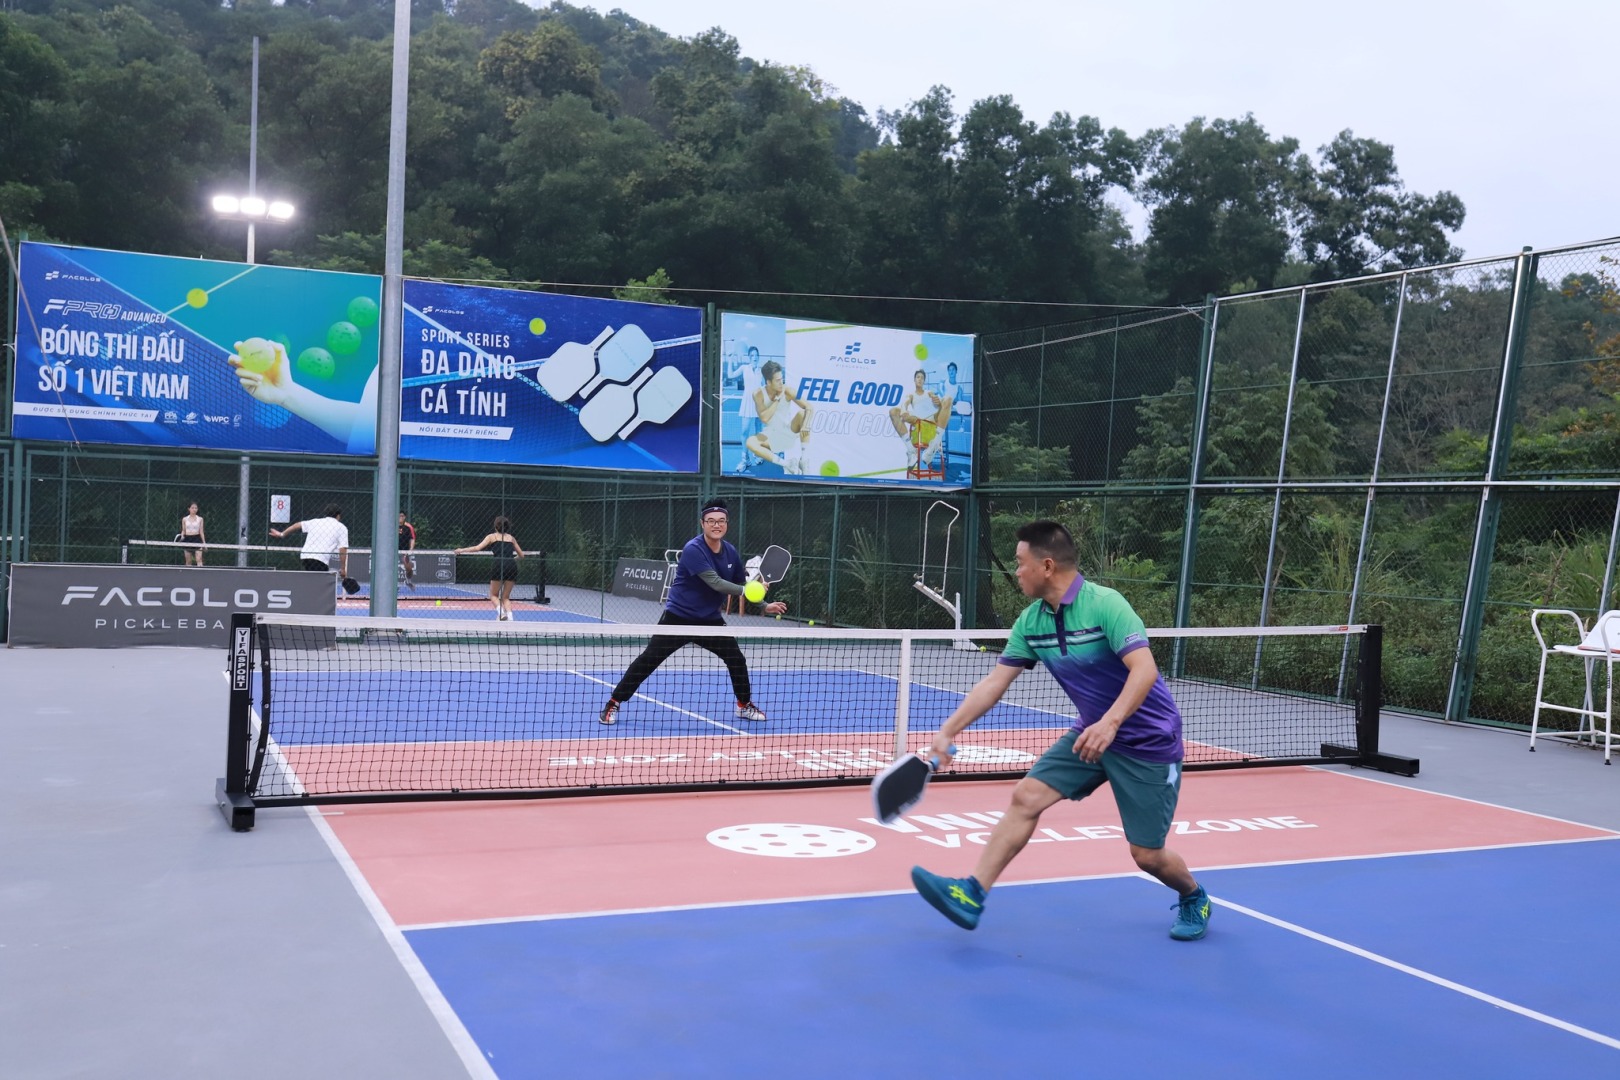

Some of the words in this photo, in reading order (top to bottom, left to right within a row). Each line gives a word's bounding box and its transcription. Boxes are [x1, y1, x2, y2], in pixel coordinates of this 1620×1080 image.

[62, 274, 101, 282] FACOLOS
[121, 310, 168, 324] ADVANCED
[40, 324, 99, 358] BÓNG
[104, 332, 138, 361] THI
[142, 330, 185, 363] ĐẤU
[421, 328, 462, 345] SPORT
[466, 332, 510, 348] SERIES
[421, 348, 450, 376] ĐA
[458, 351, 516, 383] DẠNG
[830, 355, 877, 365] FACOLOS
[38, 359, 73, 393] SỐ
[75, 368, 84, 394] 1
[91, 365, 138, 401] VIỆT
[142, 372, 190, 400] NAM
[795, 377, 841, 403] FEEL
[847, 381, 904, 407] GOOD
[421, 383, 449, 414] CÁ
[456, 386, 507, 417] TÍNH
[211, 415, 230, 423] WPC
[804, 409, 856, 435] LOOK
[857, 413, 902, 438] COO
[277, 500, 284, 510] 8
[622, 567, 664, 580] FACOLOS
[625, 582, 654, 592] PICKLEBALL
[61, 585, 292, 609] FACOLOS
[95, 618, 225, 630] PICKLEBA
[547, 753, 693, 766] ZONE
[707, 748, 896, 762] VOLLEY
[915, 825, 1126, 848] VOLE
[1171, 815, 1319, 835] ZONE
